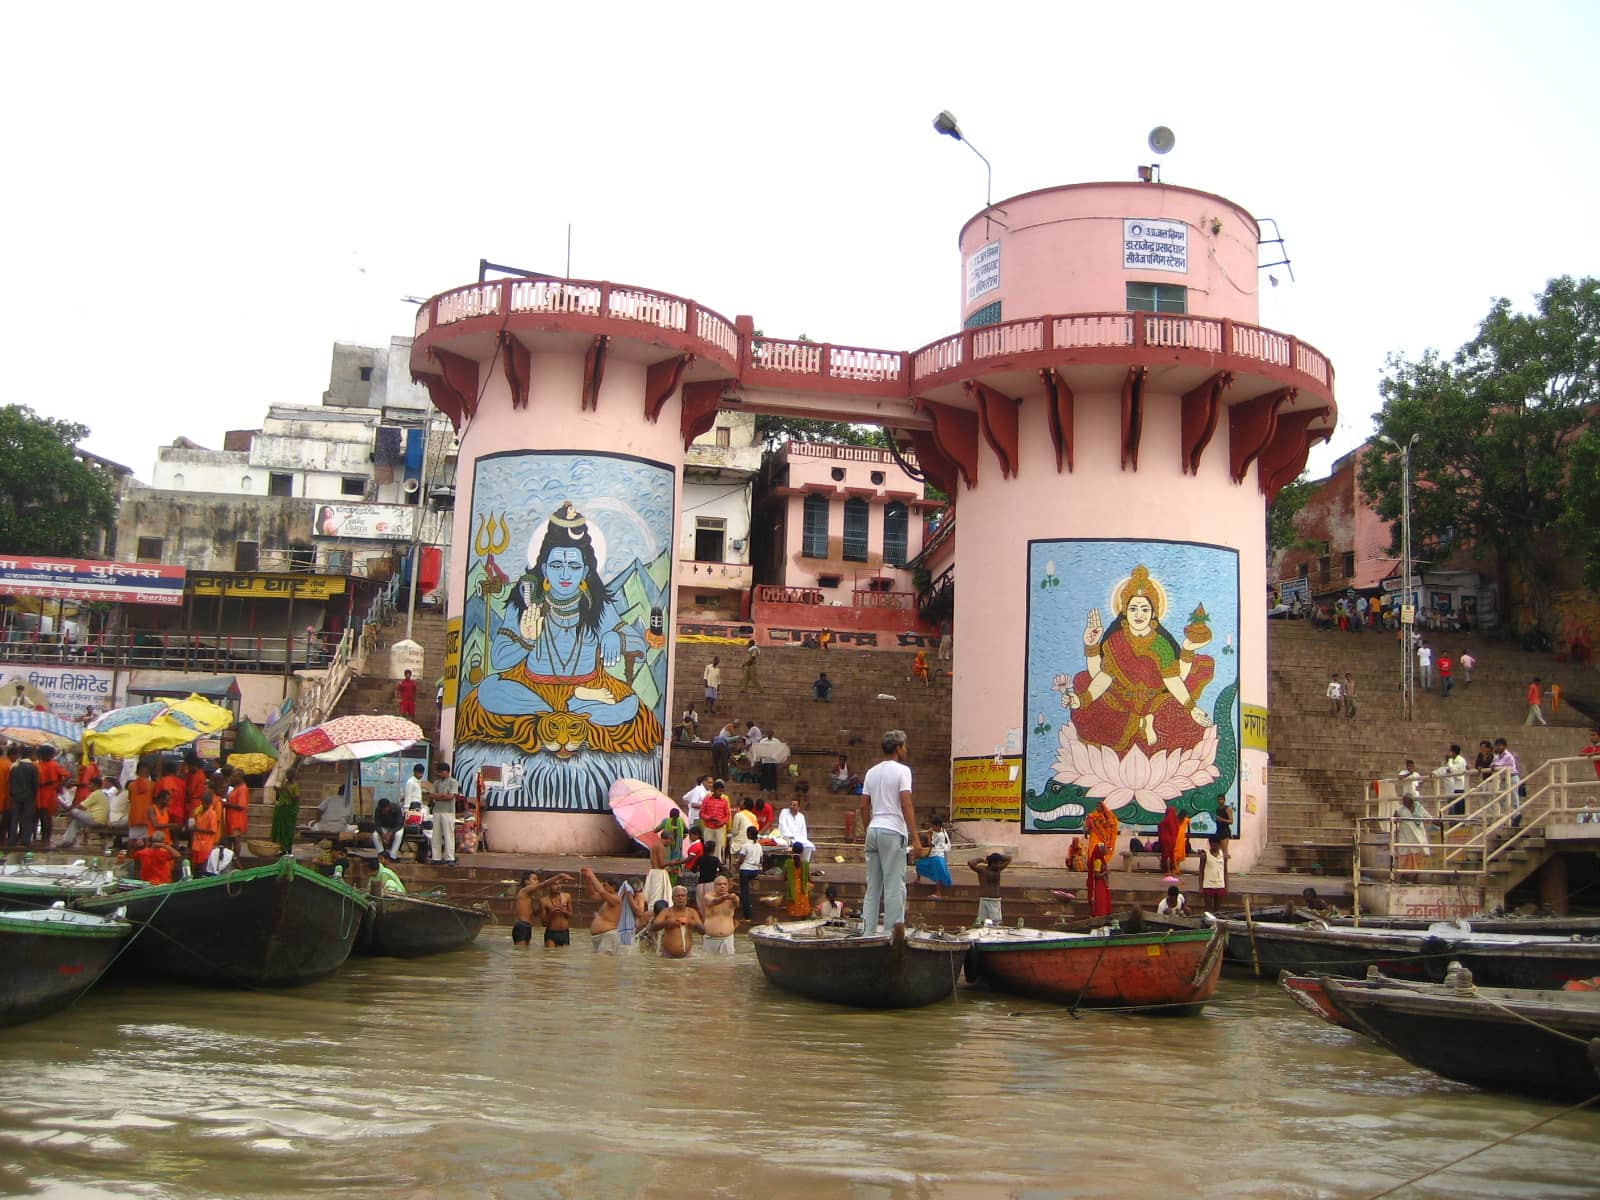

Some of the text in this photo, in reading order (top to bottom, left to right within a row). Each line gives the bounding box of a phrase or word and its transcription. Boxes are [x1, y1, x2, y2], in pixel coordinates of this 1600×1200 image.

[31, 562, 78, 574] जल
[88, 564, 163, 578] पुलिस
[135, 593, 179, 603] Peerless
[28, 671, 112, 693] निगम लिमिटेड
